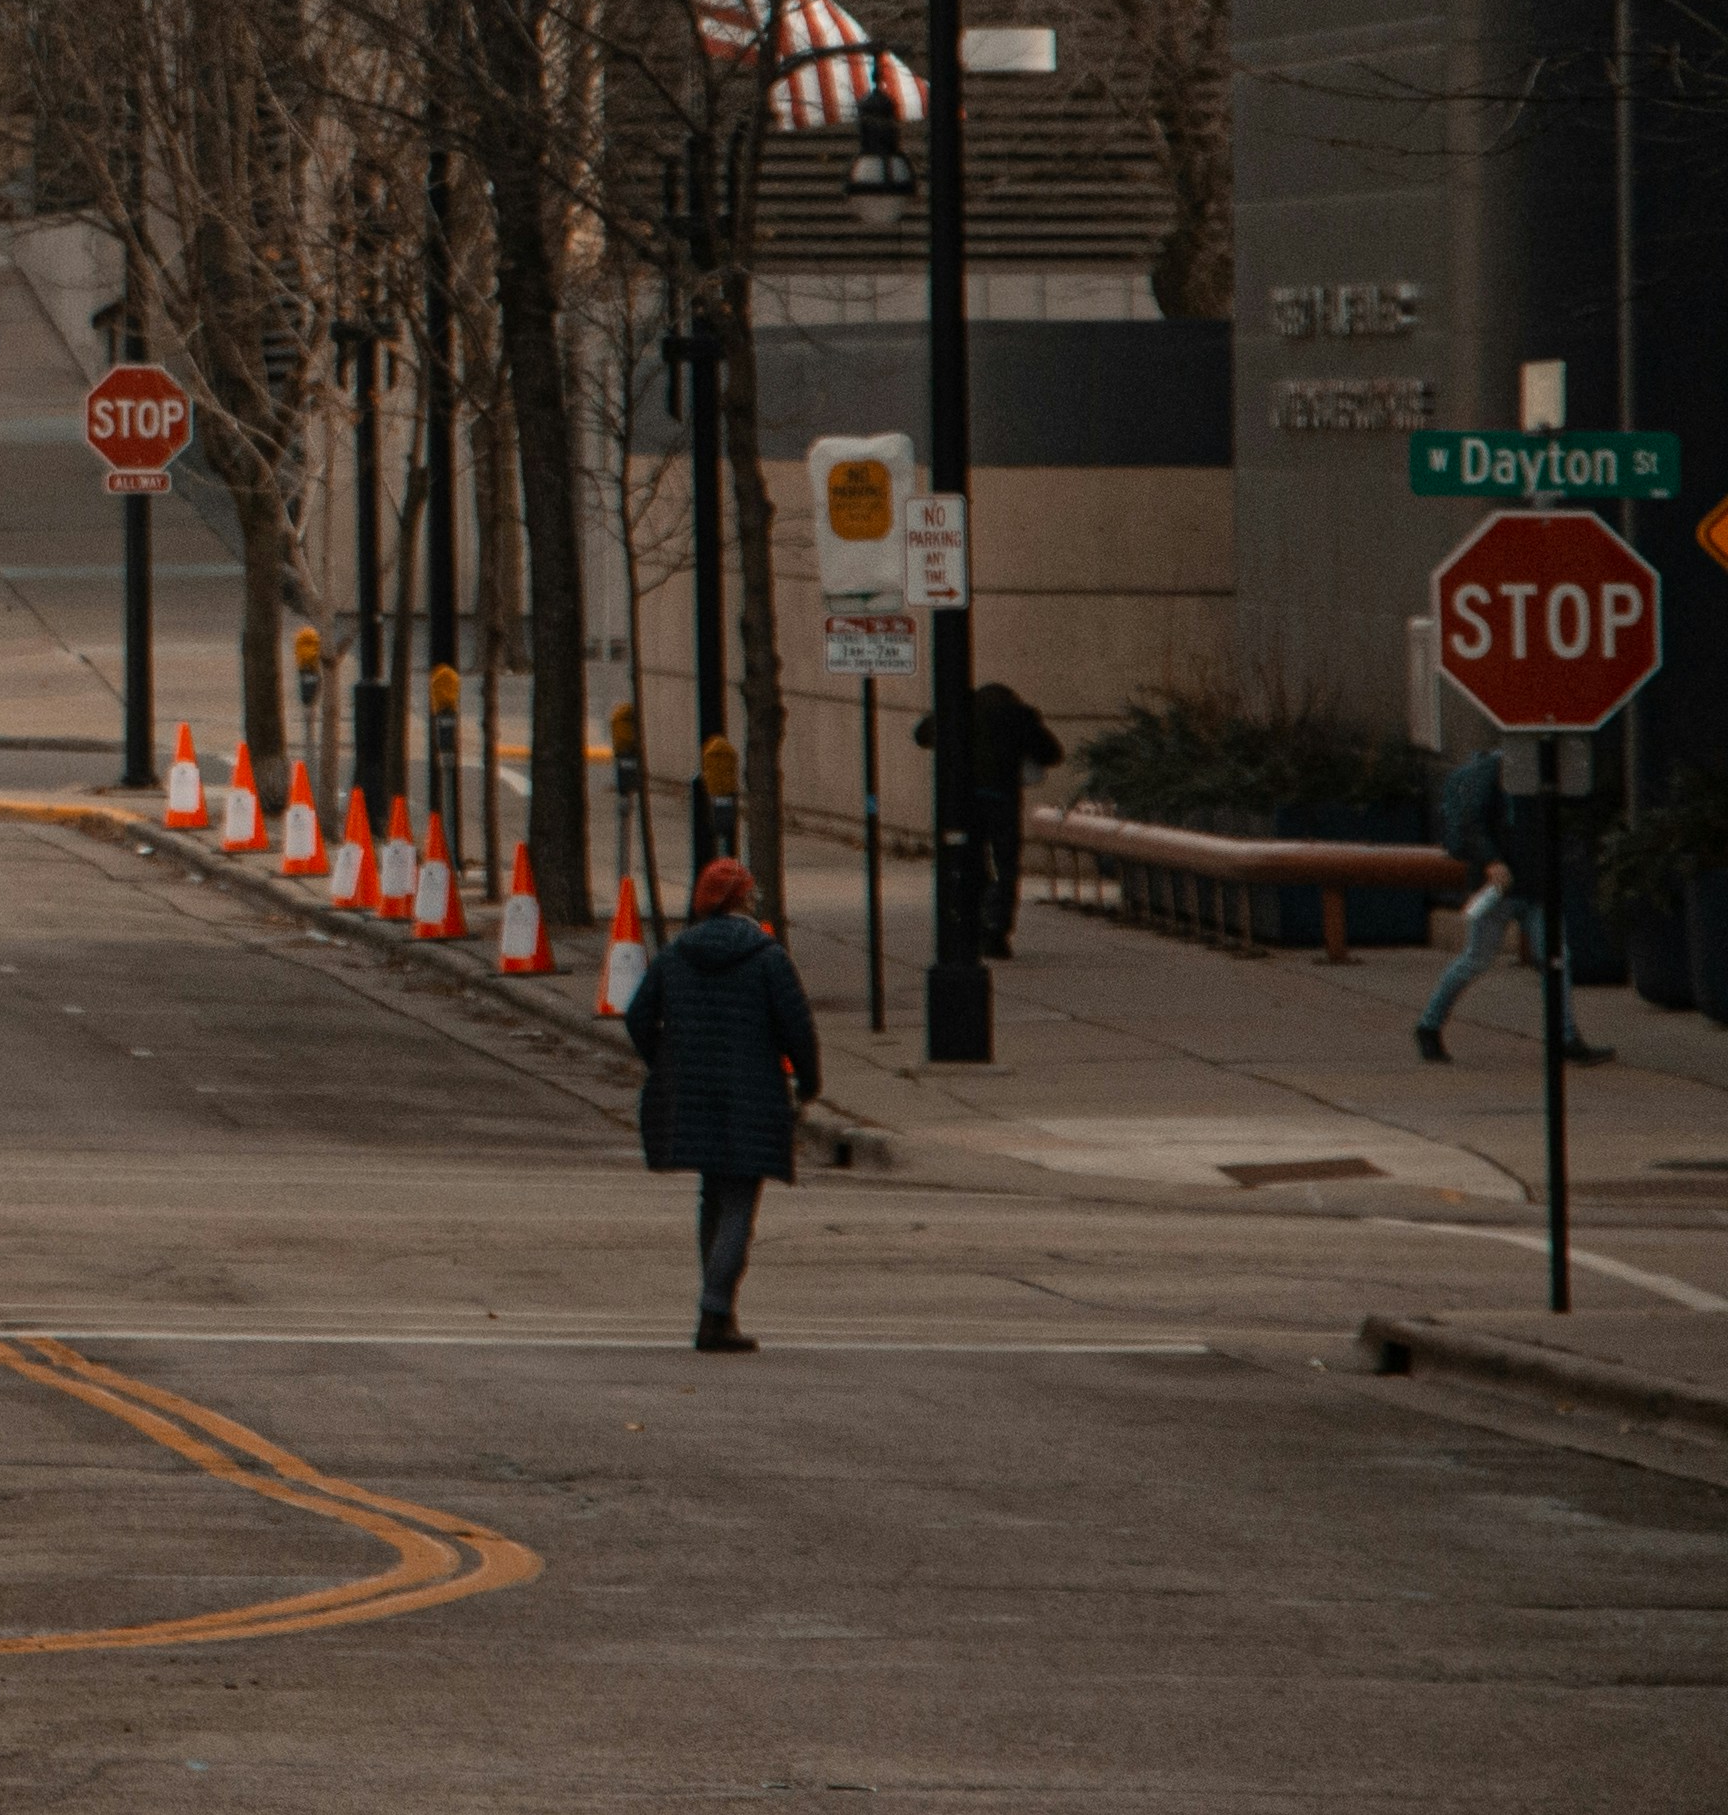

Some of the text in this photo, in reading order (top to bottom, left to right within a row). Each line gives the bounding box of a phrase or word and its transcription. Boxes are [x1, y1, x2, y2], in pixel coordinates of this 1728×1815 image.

[93, 399, 184, 439] STOP
[1428, 438, 1659, 494] W Dayton St
[924, 506, 946, 526] NO
[908, 531, 962, 547] PARKING
[926, 551, 945, 564] ANY
[925, 570, 946, 584] TIME
[1451, 583, 1643, 660] STOP
